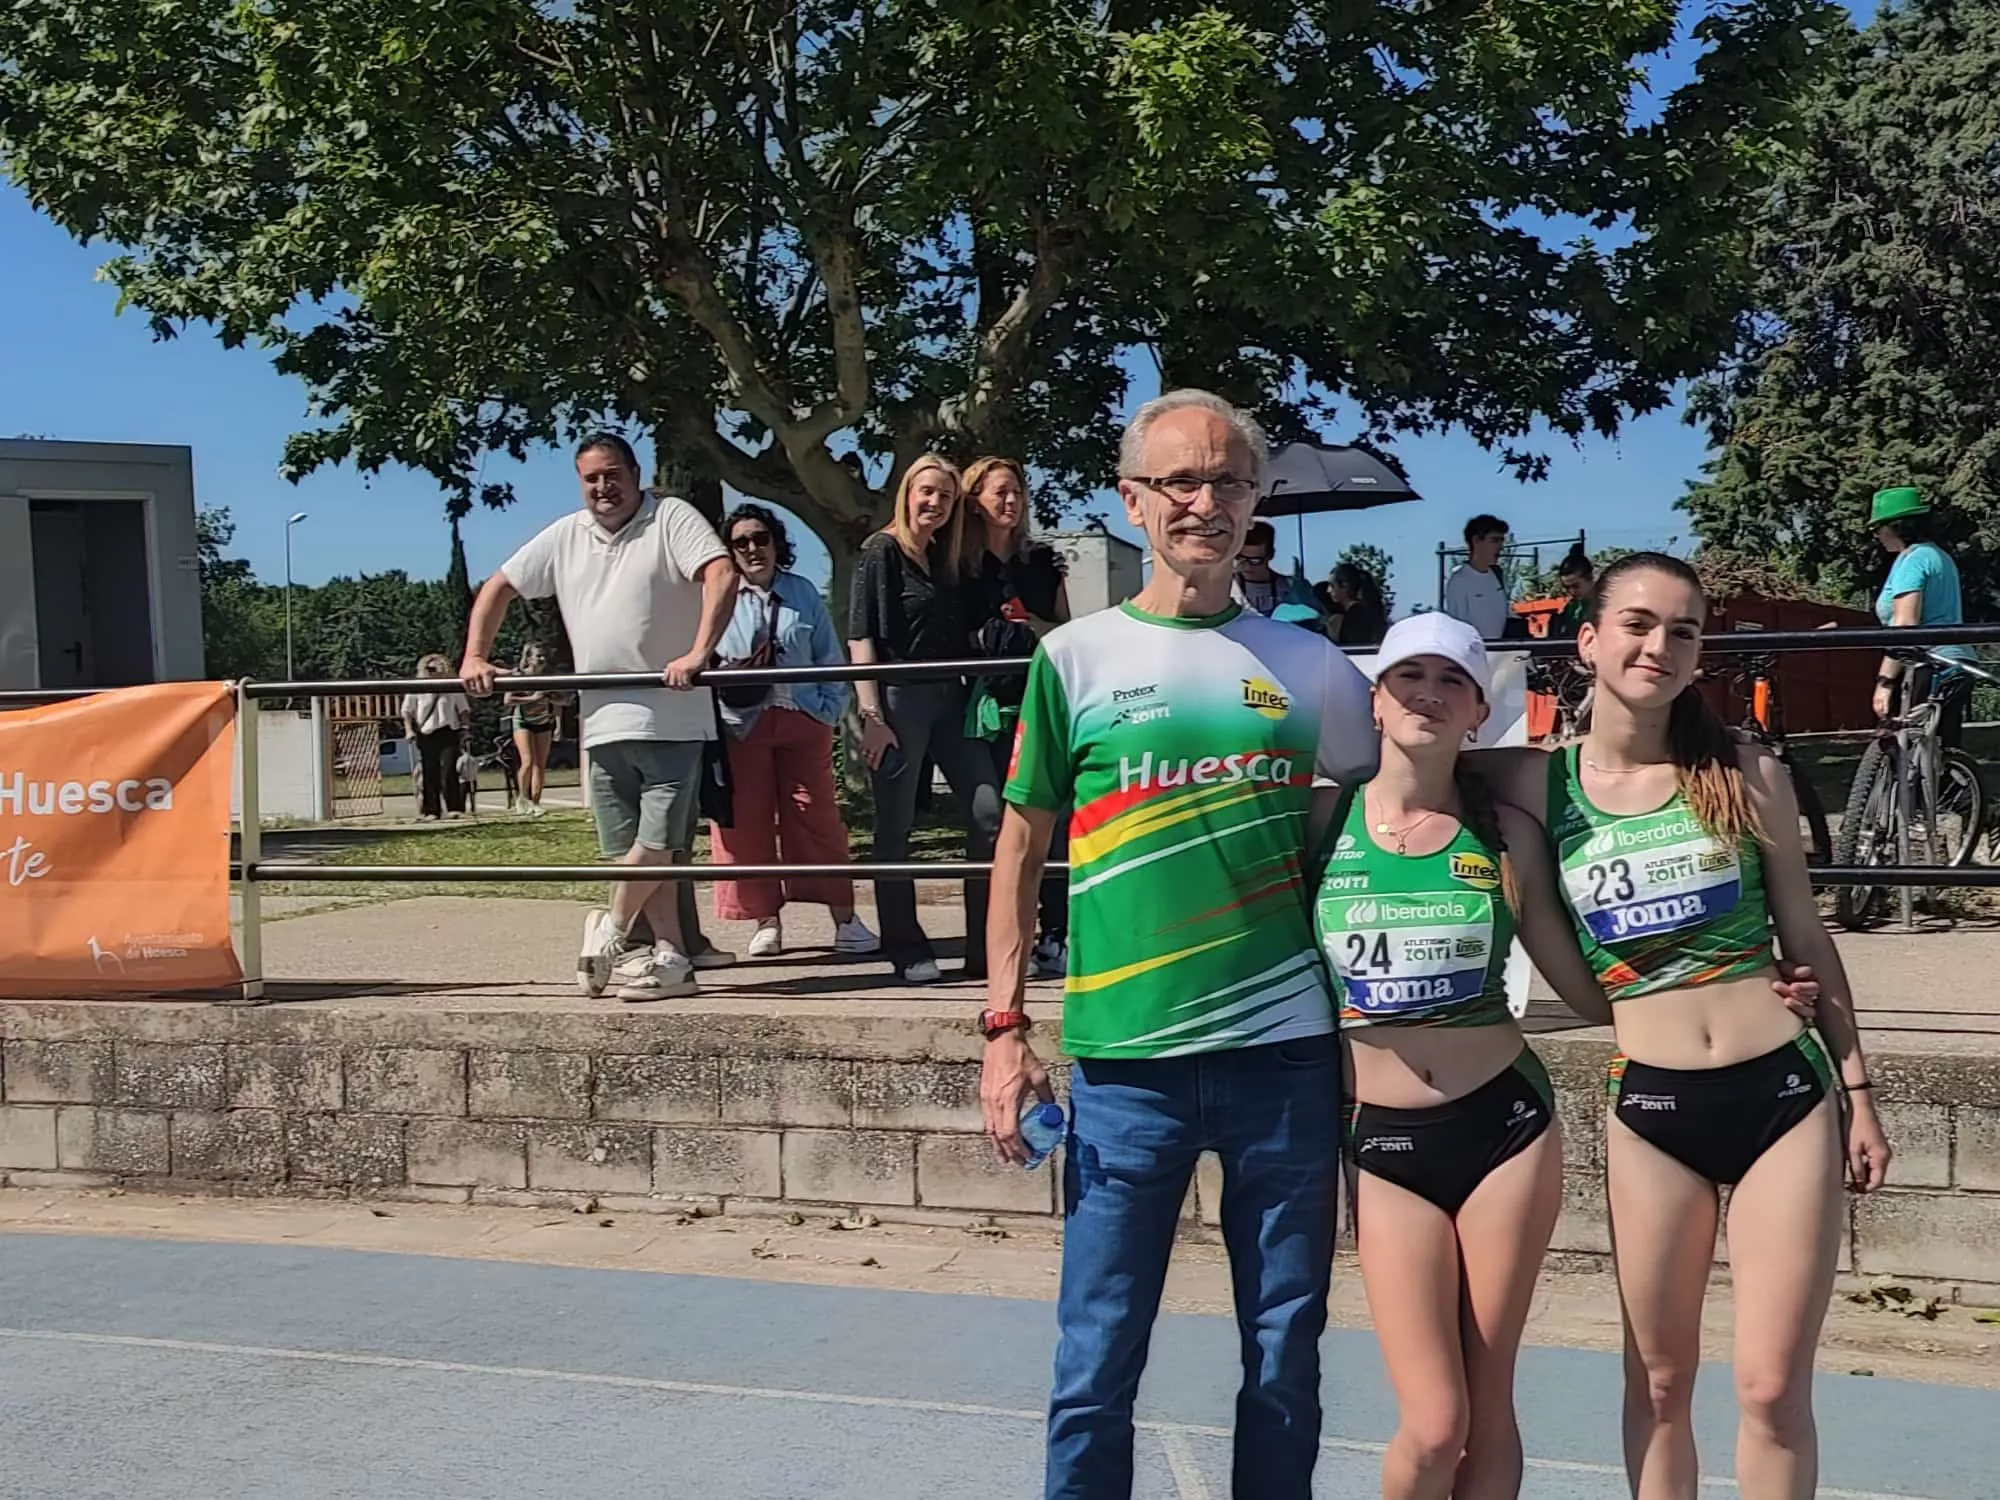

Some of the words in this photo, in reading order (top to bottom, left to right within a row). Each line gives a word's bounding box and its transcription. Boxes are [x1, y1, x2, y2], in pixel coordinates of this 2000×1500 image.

[1112, 684, 1158, 701] Protex
[0, 771, 173, 816] Huesca
[1119, 752, 1293, 793] Huesca
[1617, 818, 1702, 847] Iberdrola
[0, 835, 54, 886] te
[1588, 858, 1634, 906] 23
[1381, 903, 1465, 921] Iberdrola
[1346, 932, 1392, 976] 24
